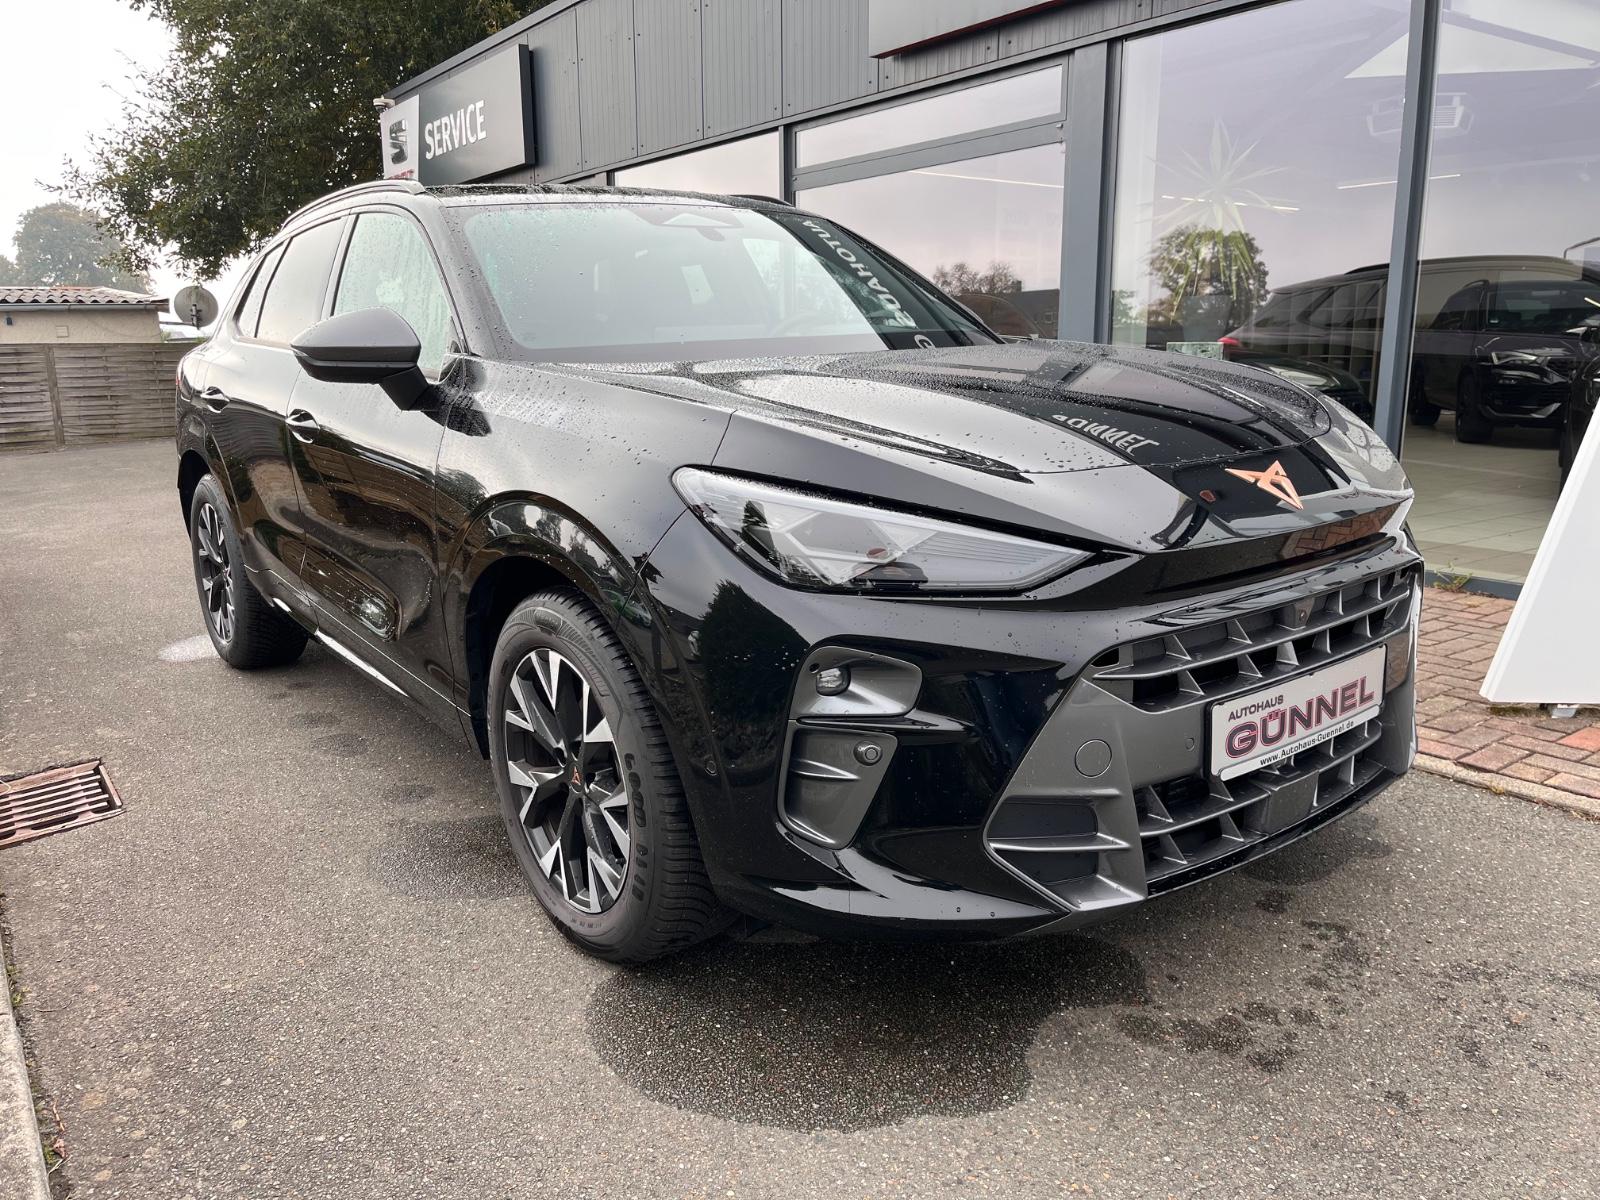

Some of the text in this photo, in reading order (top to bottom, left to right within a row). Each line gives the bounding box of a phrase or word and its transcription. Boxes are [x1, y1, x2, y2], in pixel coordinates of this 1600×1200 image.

[425, 100, 487, 160] SERVICE
[1225, 676, 1375, 759] GÜNNEL
[1228, 694, 1284, 722] AUTOHAUS
[1259, 720, 1355, 766] www.Autohaus-Guennel.de
